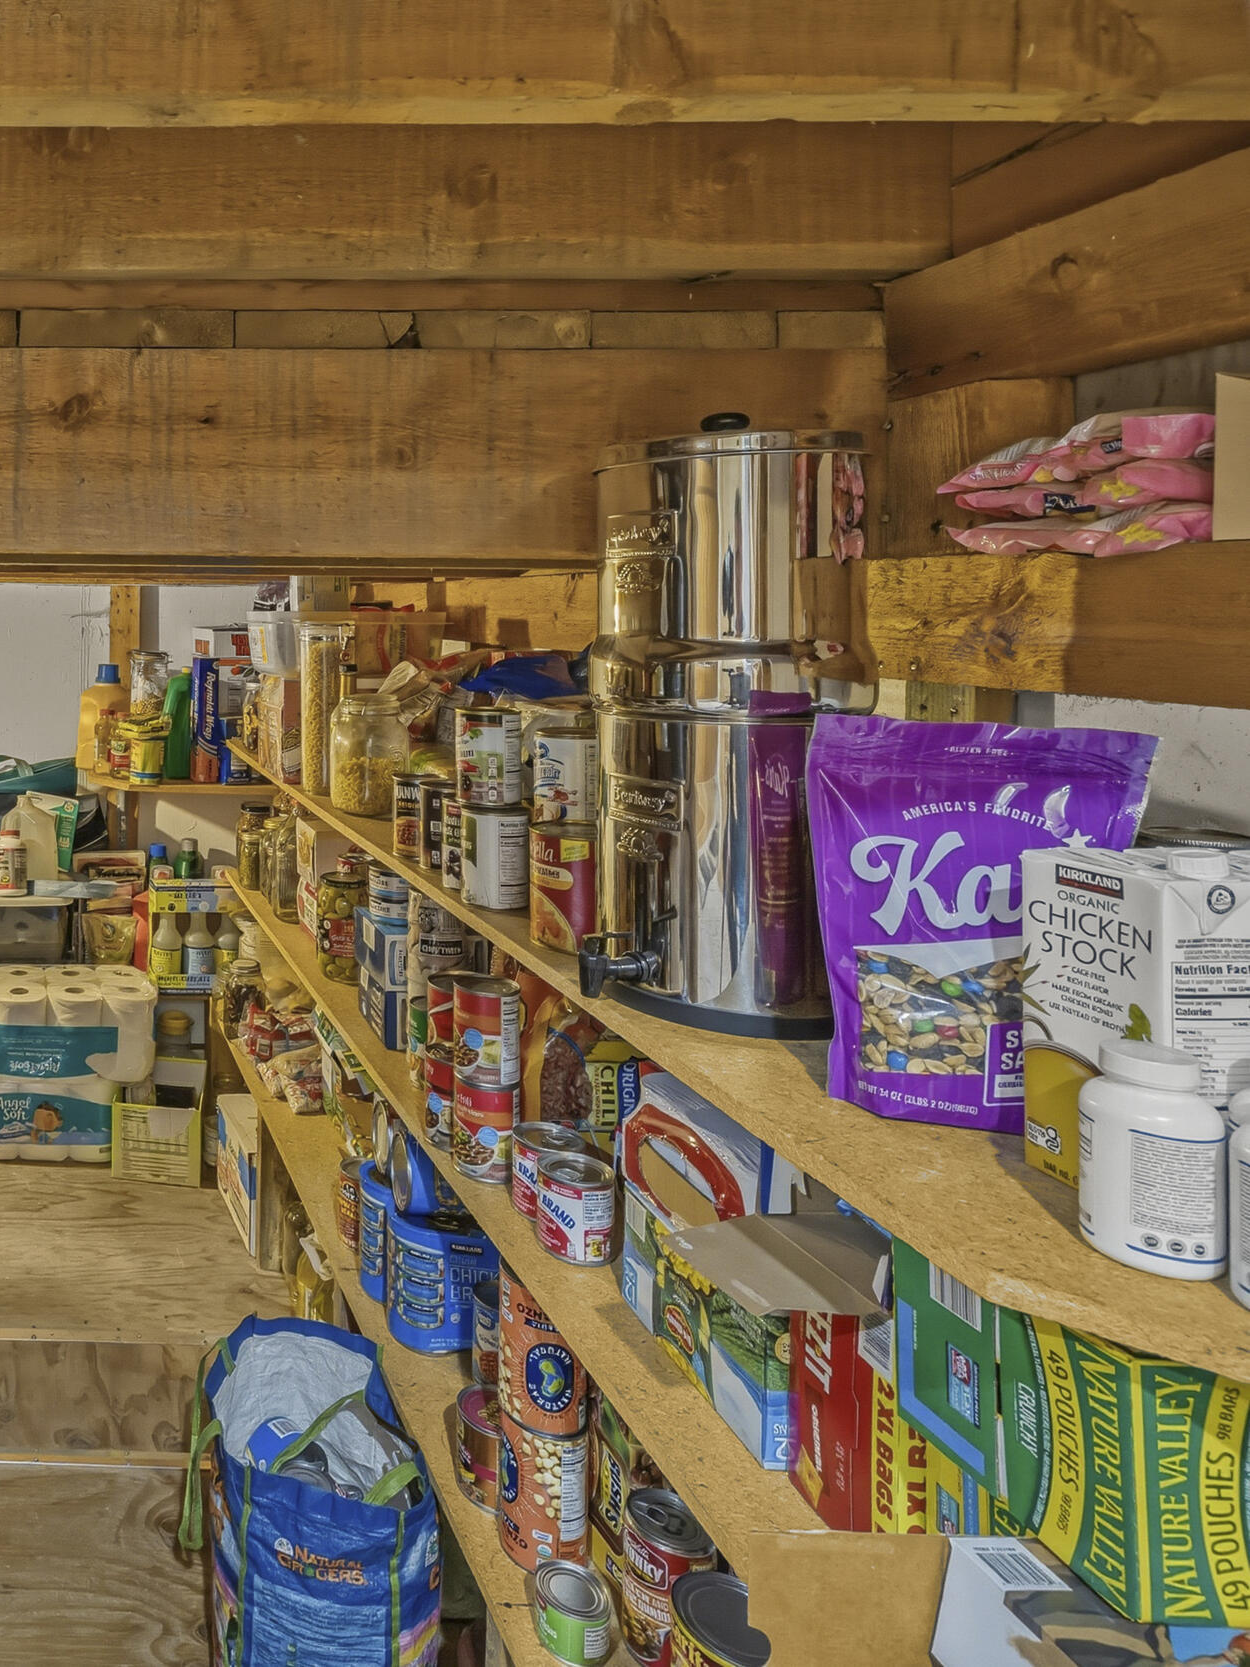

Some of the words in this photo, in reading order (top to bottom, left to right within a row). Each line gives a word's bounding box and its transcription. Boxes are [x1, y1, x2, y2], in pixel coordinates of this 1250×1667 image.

[204, 671, 217, 714] Reynolds
[203, 714, 216, 741] Wrap
[901, 800, 977, 822] AMERICA'S
[983, 803, 1054, 831] FAVORITE
[1058, 866, 1122, 891] KIRKLAND
[1057, 889, 1121, 915] ORGANIC
[1028, 899, 1153, 954] CHICKEN
[1040, 930, 1137, 981] STOCK
[1174, 965, 1223, 976] Nutrition
[1175, 1007, 1213, 1017] Calories
[600, 1065, 616, 1127] CHILI
[622, 1062, 638, 1121] ORIGIN
[3, 1107, 30, 1122] Soft
[517, 1161, 538, 1185] BRA
[541, 1193, 577, 1230] BRAND
[450, 1268, 500, 1284] CHICK
[1046, 1349, 1069, 1380] 49
[877, 1376, 895, 1396] 2
[1217, 1385, 1241, 1421] BARS
[877, 1398, 895, 1435] XL
[1016, 1381, 1039, 1459] CRUNCHY
[1075, 1341, 1123, 1484] NATURE
[1051, 1381, 1081, 1493] POUCHES
[1154, 1374, 1203, 1490] VALLEY
[1215, 1424, 1231, 1441] 98
[1204, 1450, 1243, 1575] POUCHES
[295, 1543, 365, 1571] NATURAL
[1081, 1484, 1127, 1608] VALLEY
[1158, 1491, 1213, 1620] NATURE
[1221, 1580, 1250, 1611] 49
